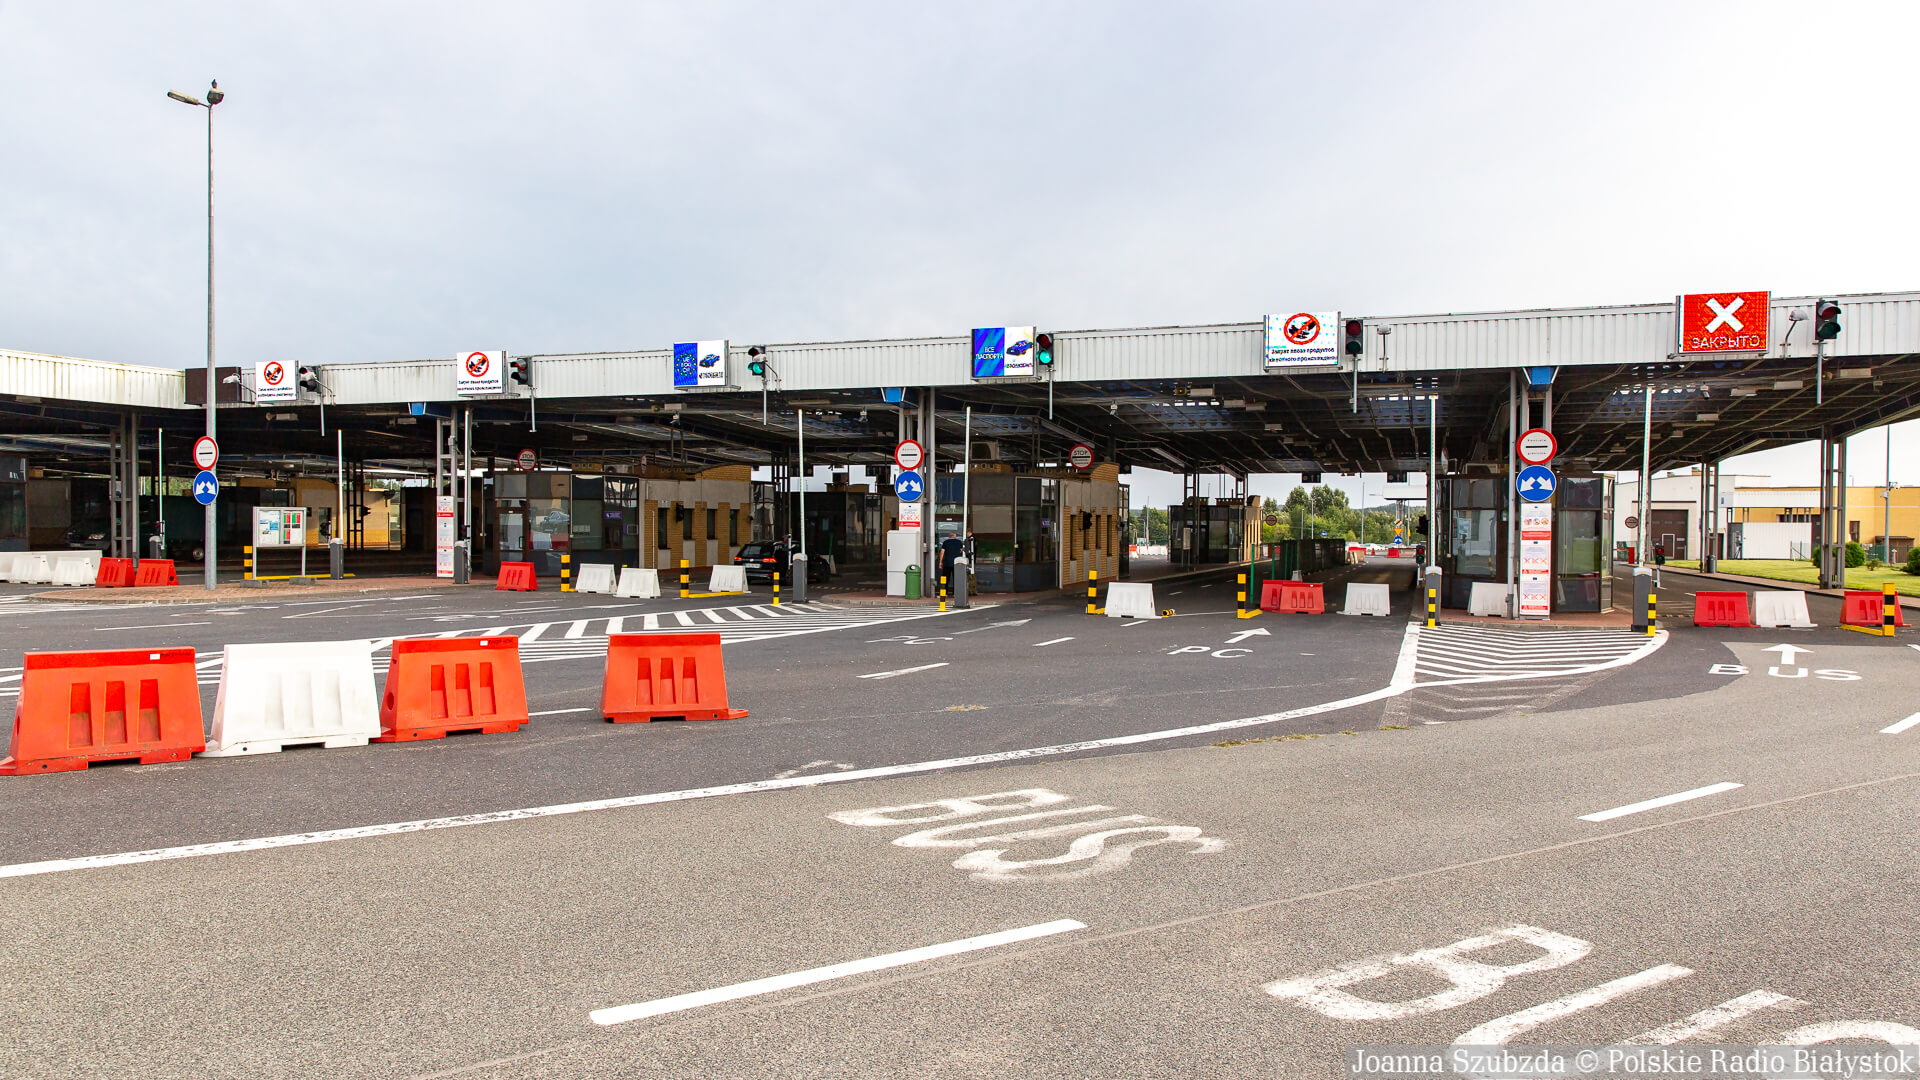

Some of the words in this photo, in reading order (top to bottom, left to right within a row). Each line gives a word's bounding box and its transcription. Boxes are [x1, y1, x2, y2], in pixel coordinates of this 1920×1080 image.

[1691, 335, 1760, 348] ЗАКРЫТО
[1708, 663, 1863, 682] BUS
[825, 788, 1228, 882] BUS
